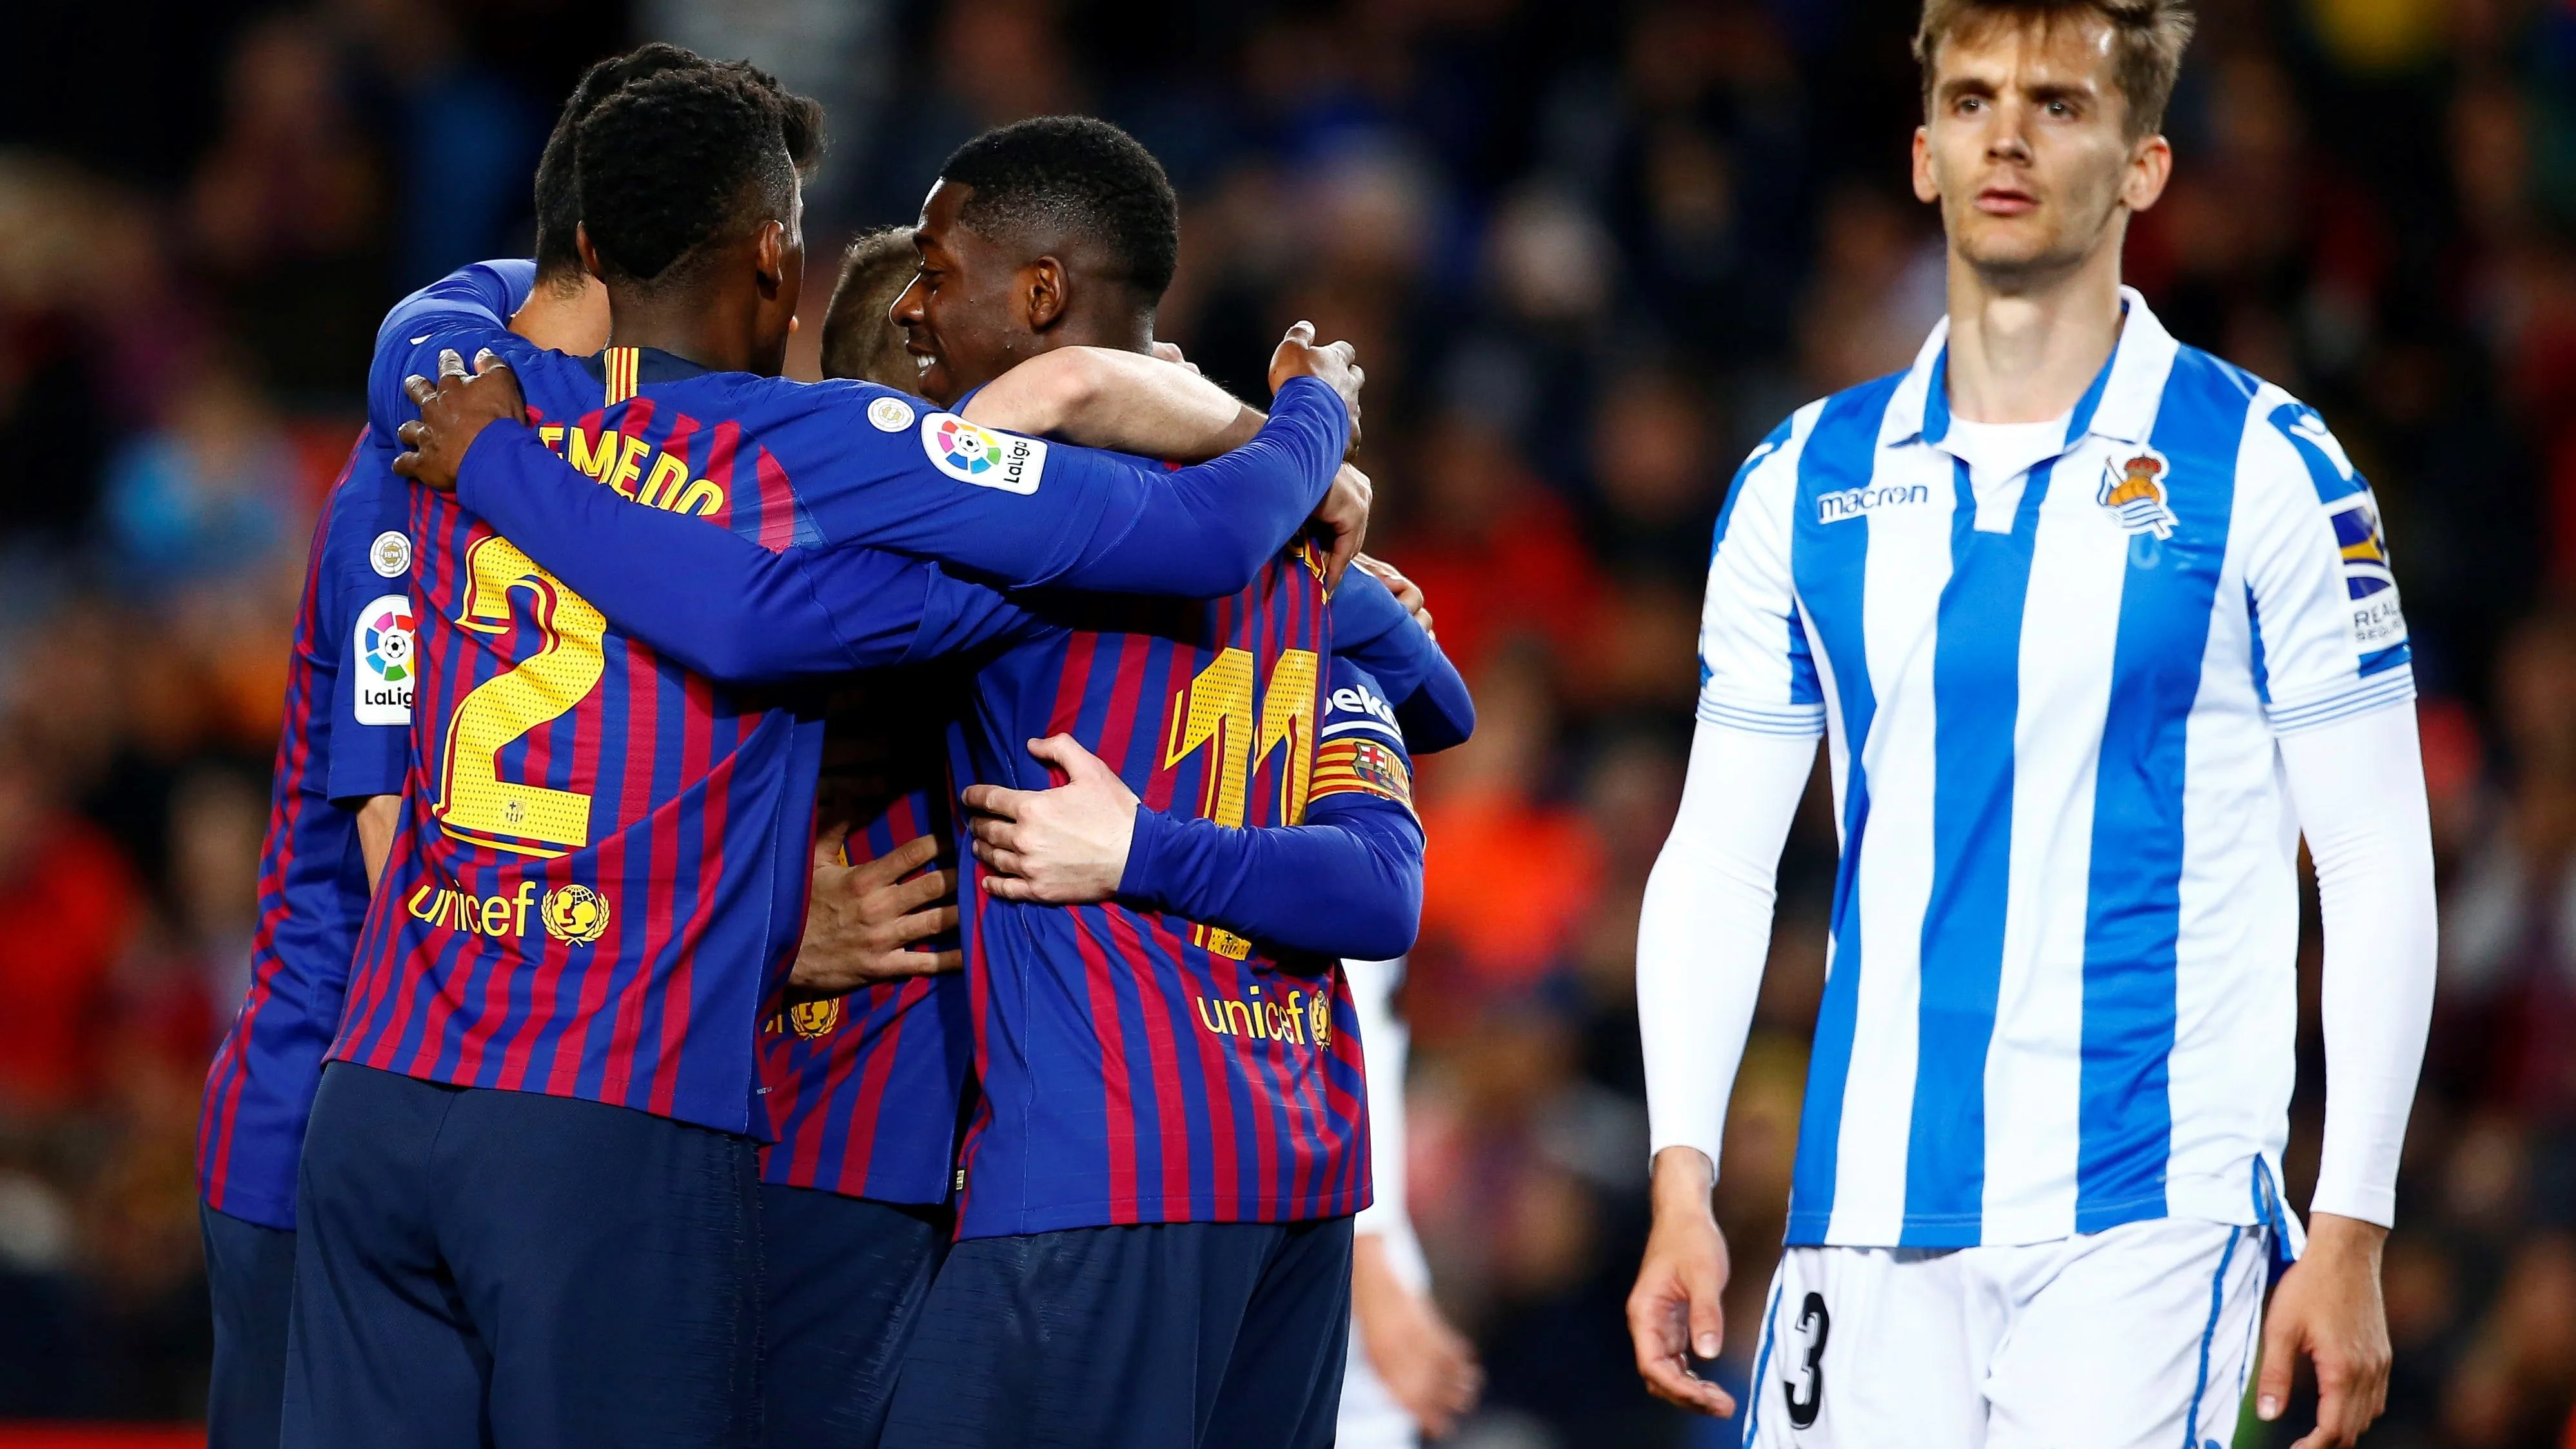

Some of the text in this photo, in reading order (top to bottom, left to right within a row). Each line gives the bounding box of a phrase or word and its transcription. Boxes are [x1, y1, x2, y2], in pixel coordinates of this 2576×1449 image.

[1003, 441, 1030, 484] LaLiga
[1820, 485, 1928, 520] macron
[432, 535, 607, 859] 2
[1163, 647, 1318, 961] 11
[408, 880, 536, 937] unicef
[1196, 985, 1305, 1045] unicef
[1784, 1292, 1829, 1430] 3
